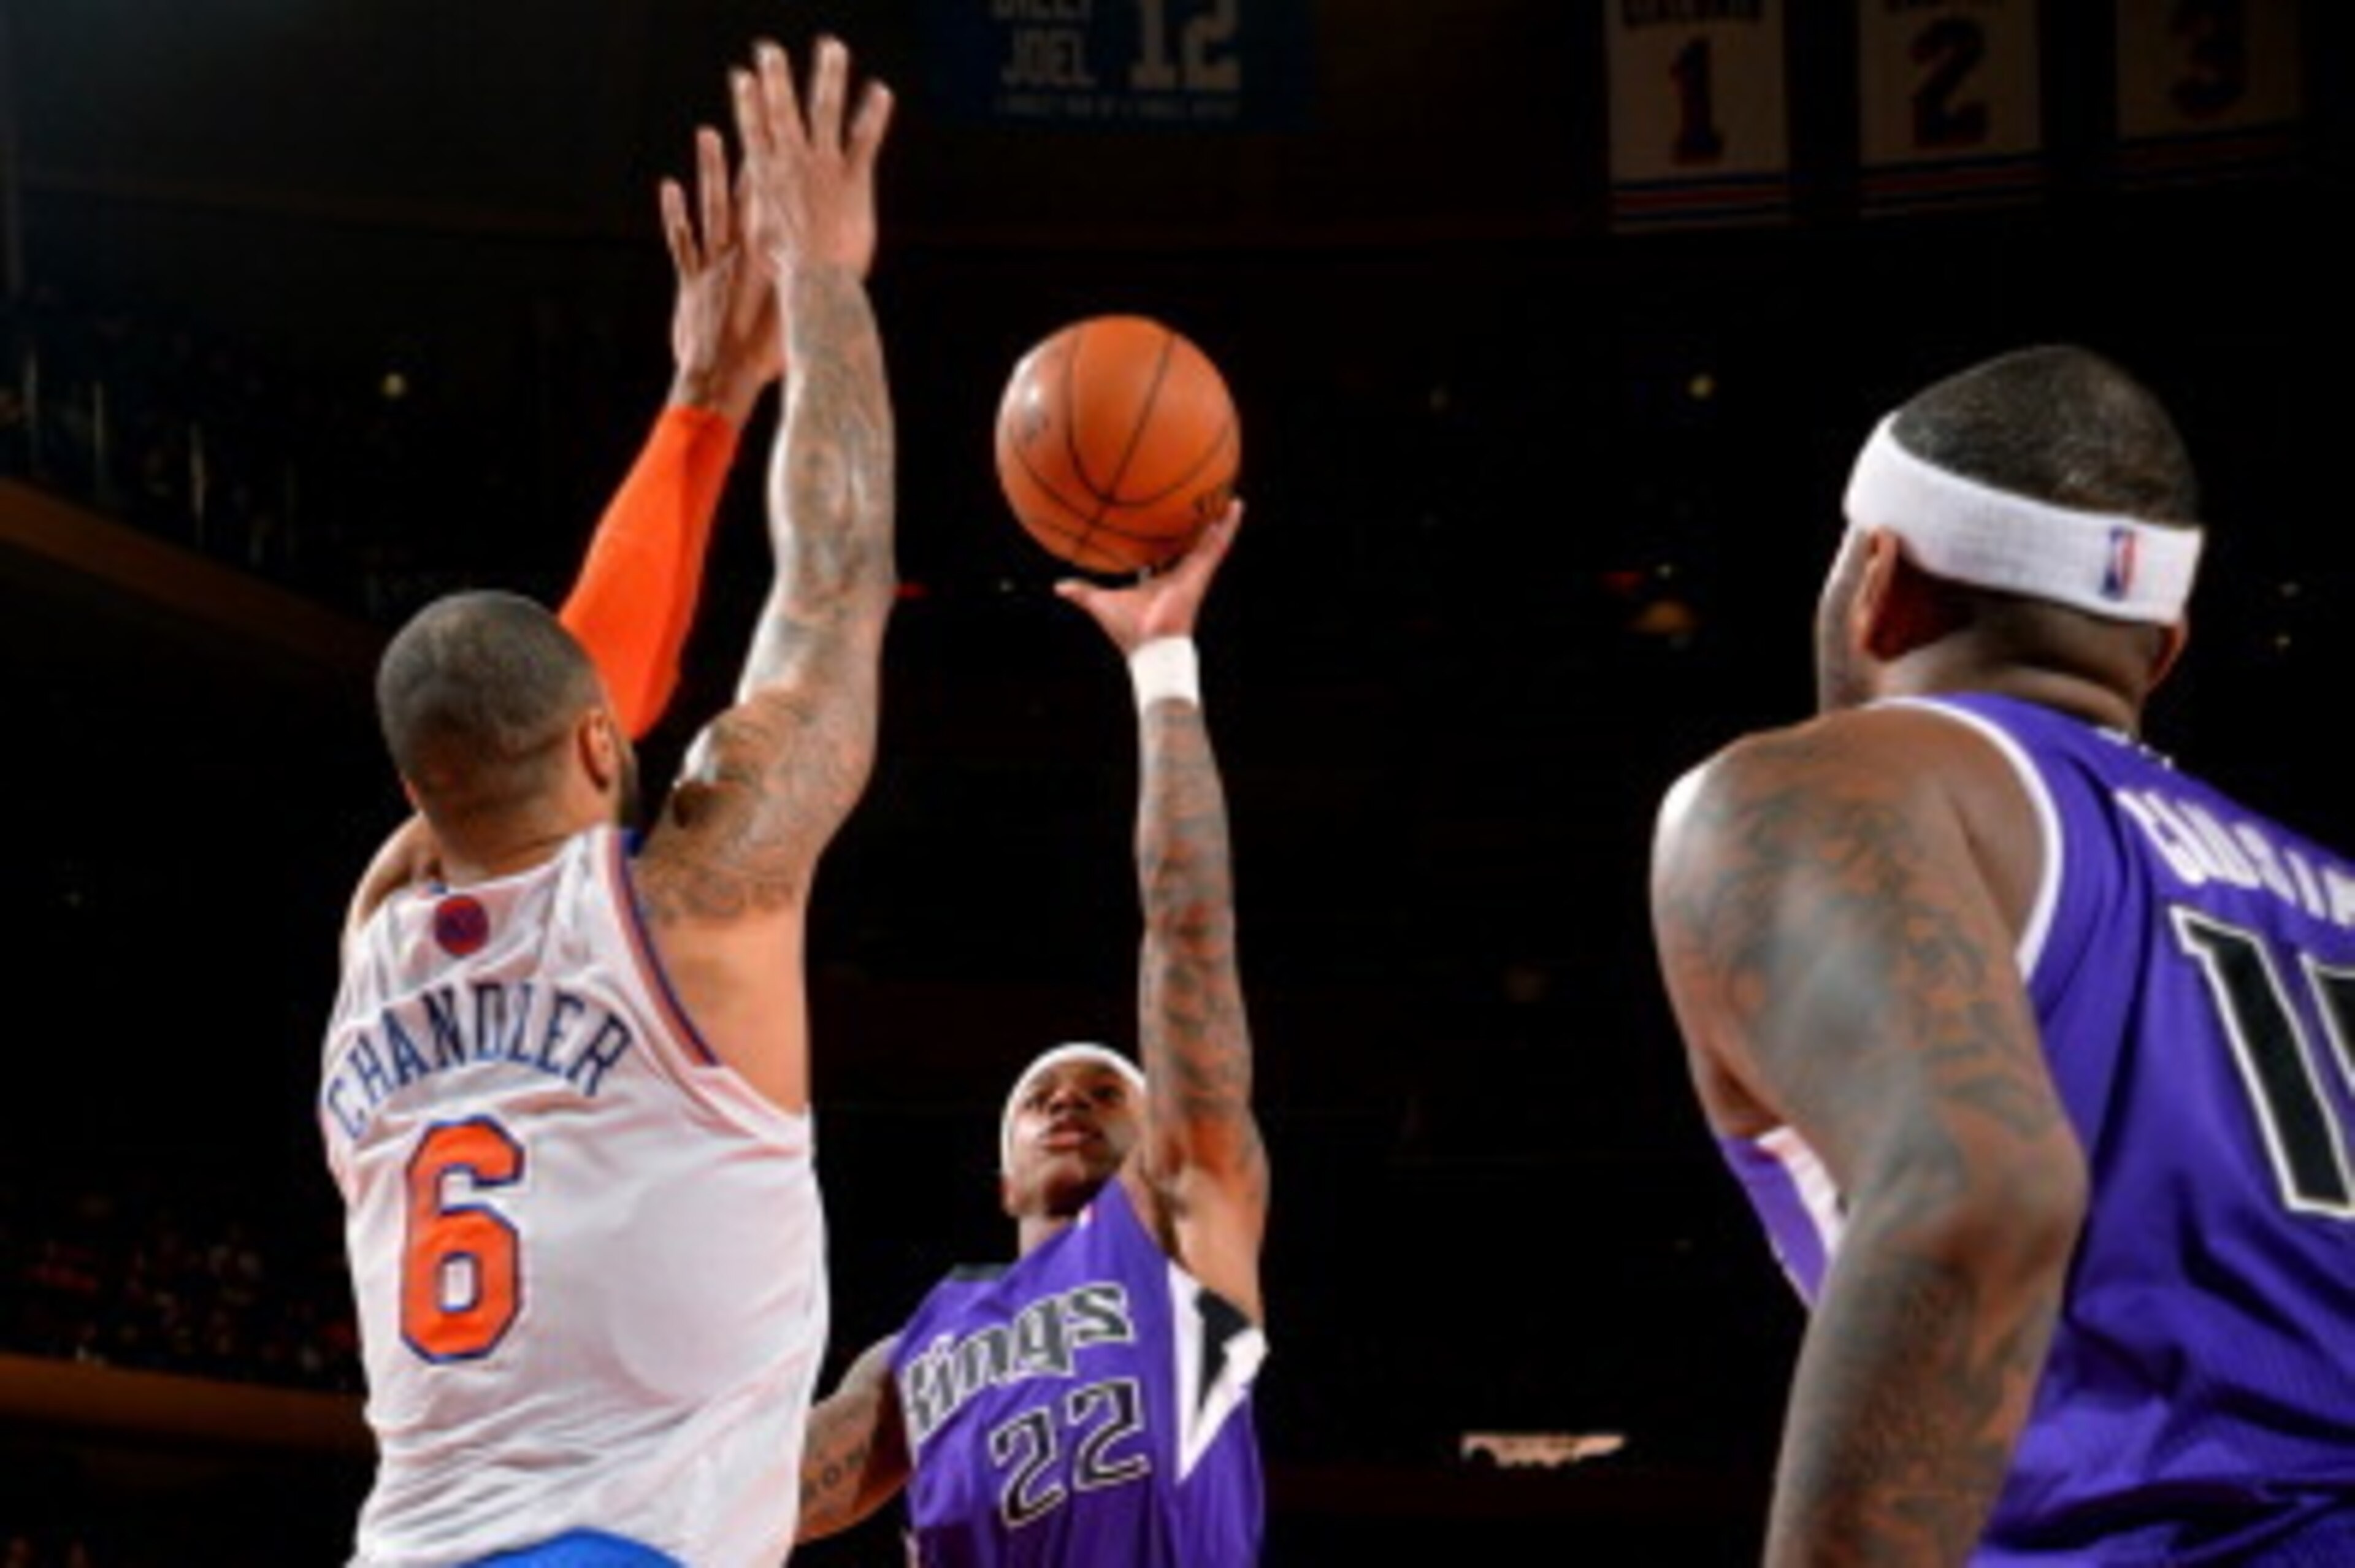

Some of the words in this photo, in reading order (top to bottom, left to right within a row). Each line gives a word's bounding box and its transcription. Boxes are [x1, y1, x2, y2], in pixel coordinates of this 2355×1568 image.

[1000, 28, 1098, 87] JOEL
[1130, 0, 1240, 91] 12
[1671, 37, 1723, 164] 1
[1910, 17, 1988, 147] 2
[2170, 0, 2248, 119] 3
[325, 981, 633, 1141] CHANDLER
[399, 1114, 526, 1365] 6
[987, 1376, 1151, 1529] 22
